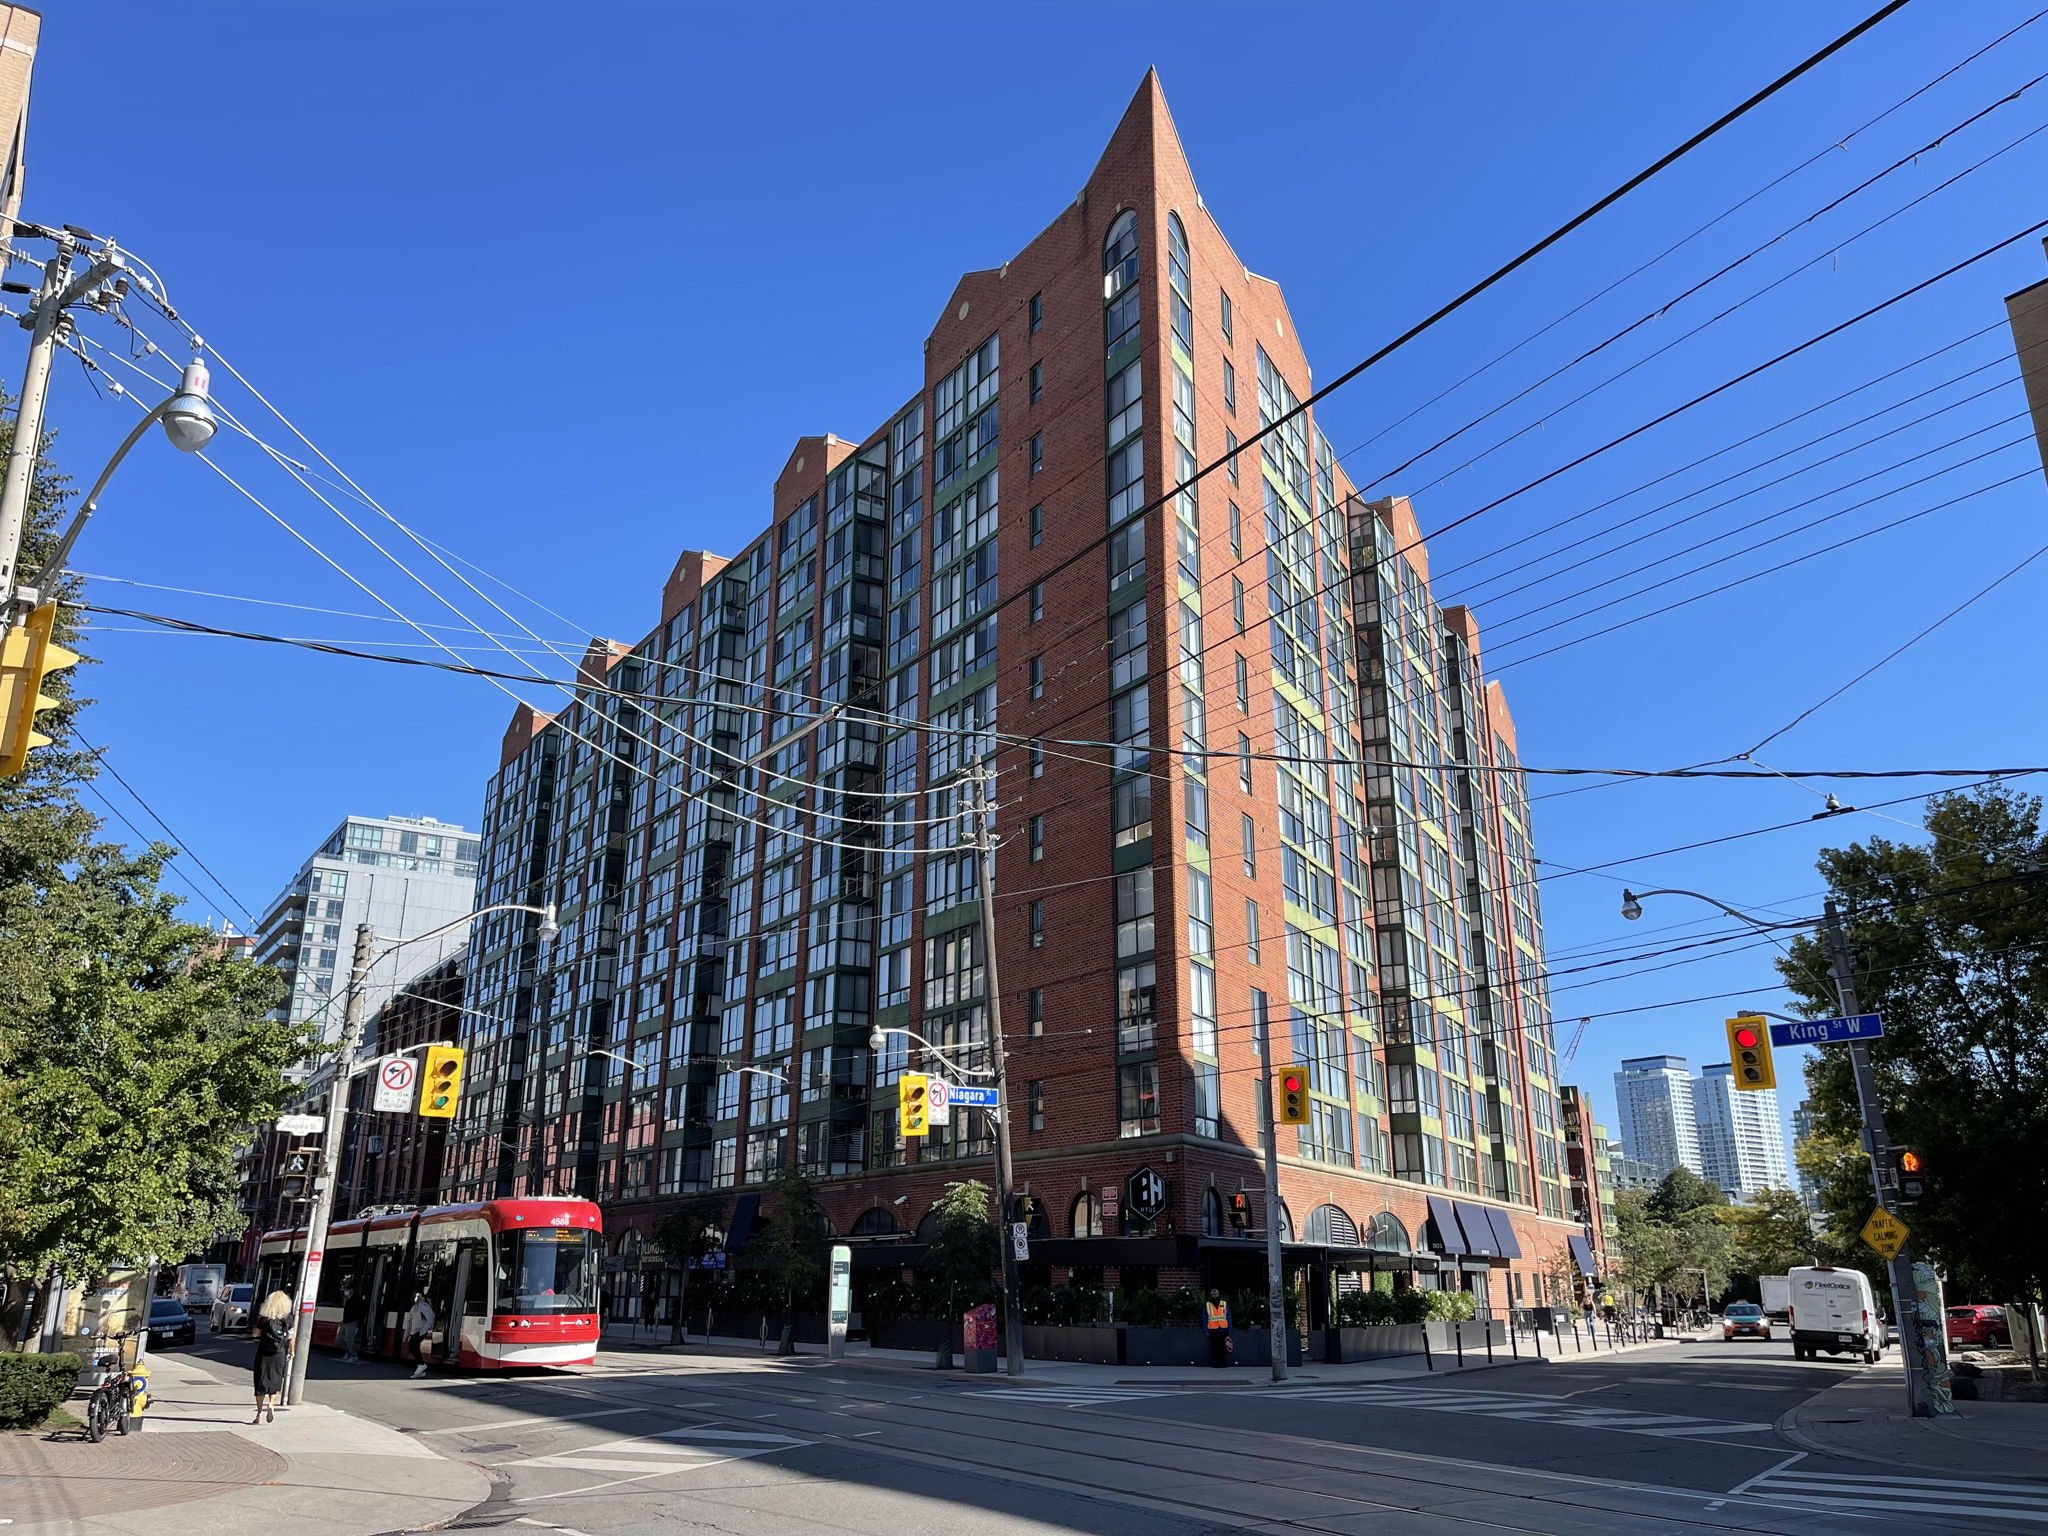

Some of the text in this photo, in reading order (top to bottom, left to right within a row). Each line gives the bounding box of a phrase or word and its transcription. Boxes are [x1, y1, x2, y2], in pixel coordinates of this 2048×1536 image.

[1789, 1018, 1860, 1040] King St W
[949, 1088, 984, 1104] Niagara
[1871, 1218, 1895, 1229] TRAFFIC
[1873, 1230, 1898, 1242] CALMING
[1881, 1242, 1896, 1253] ZONE
[1814, 1281, 1851, 1290] FleetOptics
